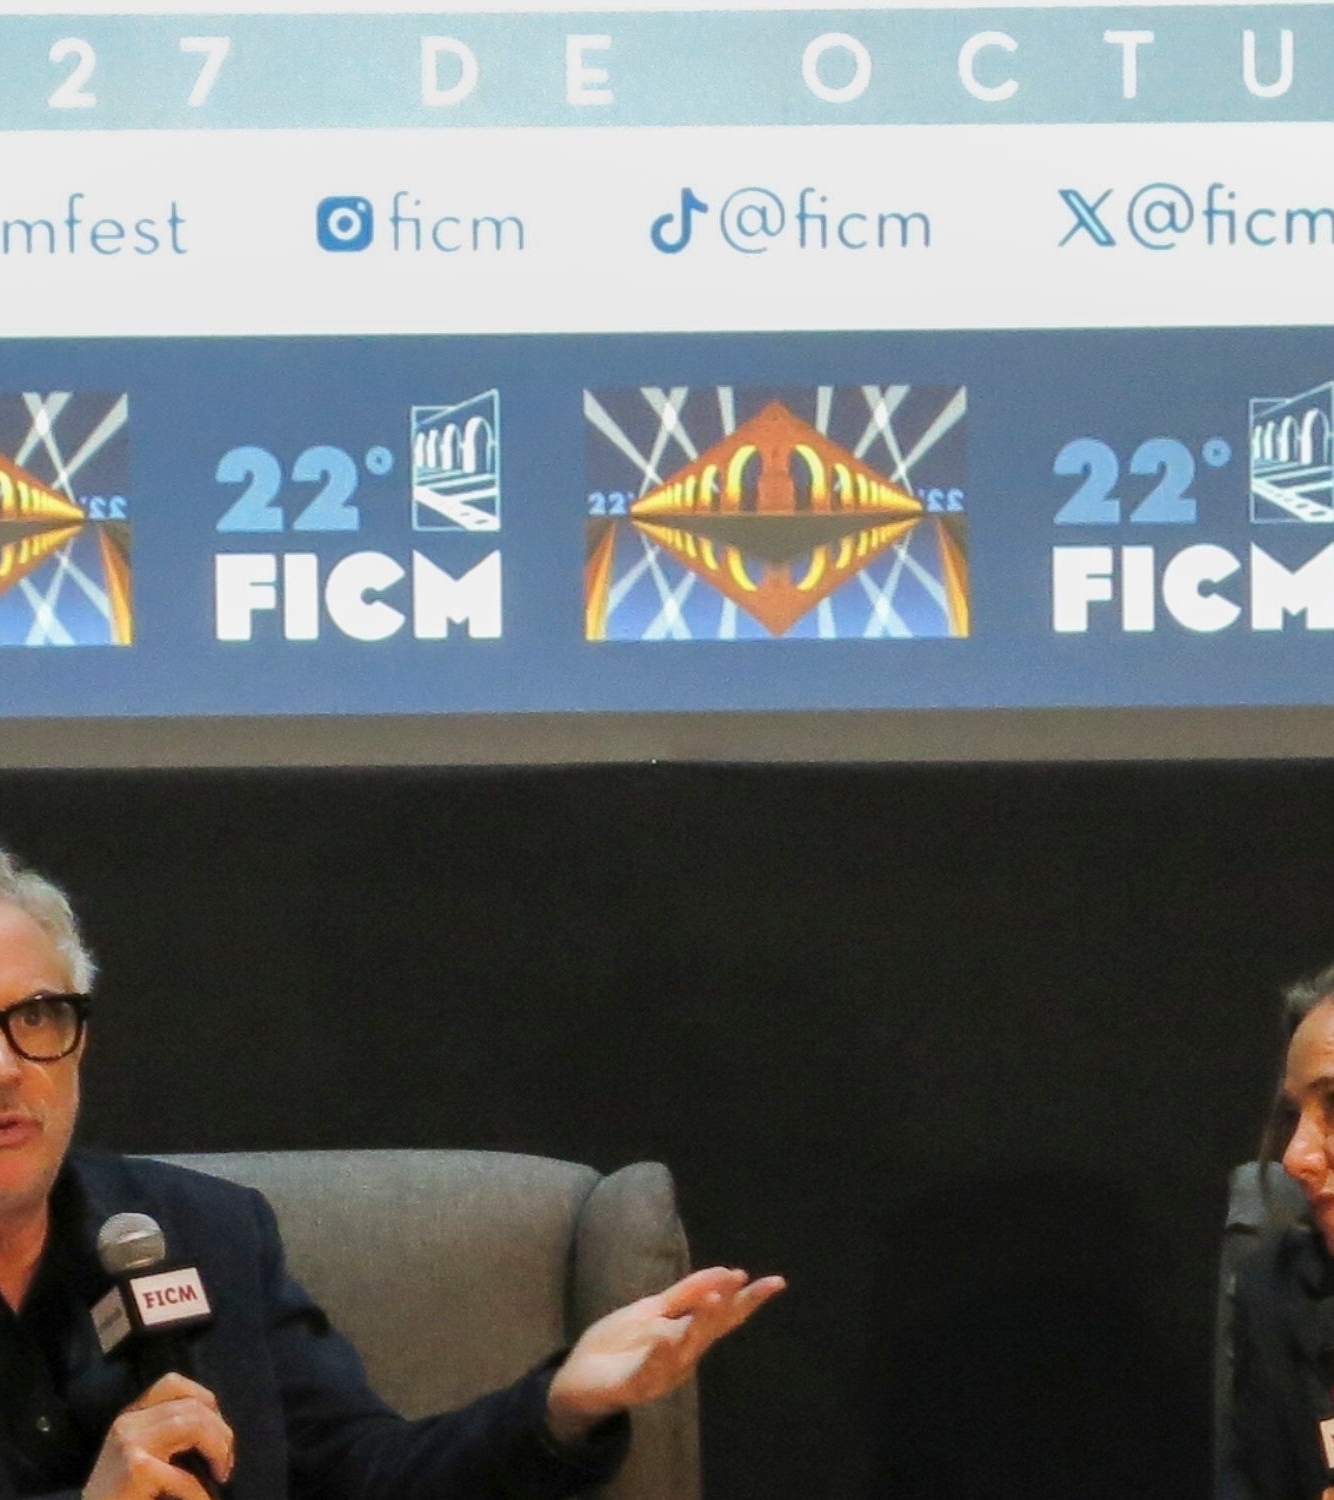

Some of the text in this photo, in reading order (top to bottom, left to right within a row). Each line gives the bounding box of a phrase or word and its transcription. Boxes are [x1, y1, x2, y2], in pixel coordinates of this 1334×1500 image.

[47, 37, 232, 108] 27
[420, 35, 614, 108] DE
[389, 191, 526, 253] ficm
[719, 187, 932, 253] @ficm
[216, 446, 393, 532] 22°
[1054, 438, 1232, 524] 22°
[216, 552, 502, 640] FICM
[142, 1284, 198, 1309] FICM
